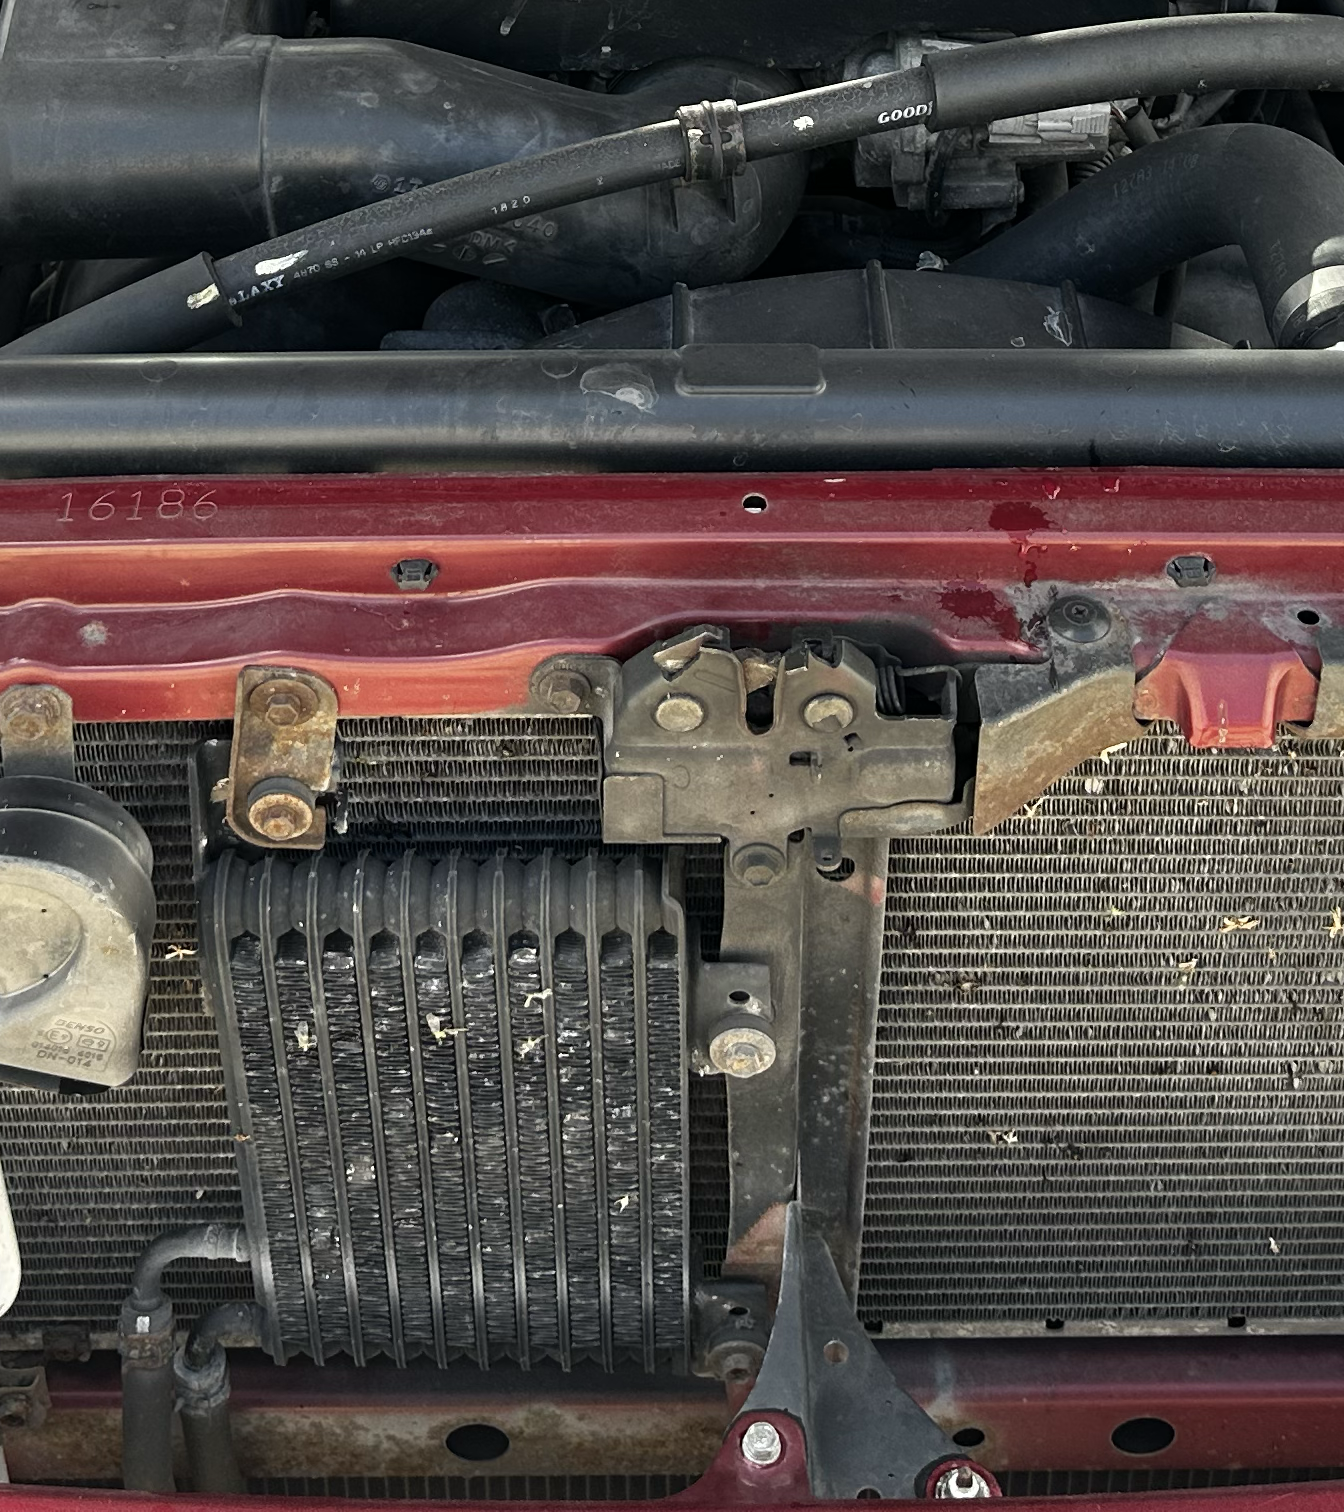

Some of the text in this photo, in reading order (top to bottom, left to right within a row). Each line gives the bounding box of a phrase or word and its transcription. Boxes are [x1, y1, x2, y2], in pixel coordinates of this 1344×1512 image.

[370, 241, 384, 255] LP
[57, 488, 219, 523] 16186
[54, 1019, 105, 1035] DENSO
[35, 1049, 92, 1068] DN-014
